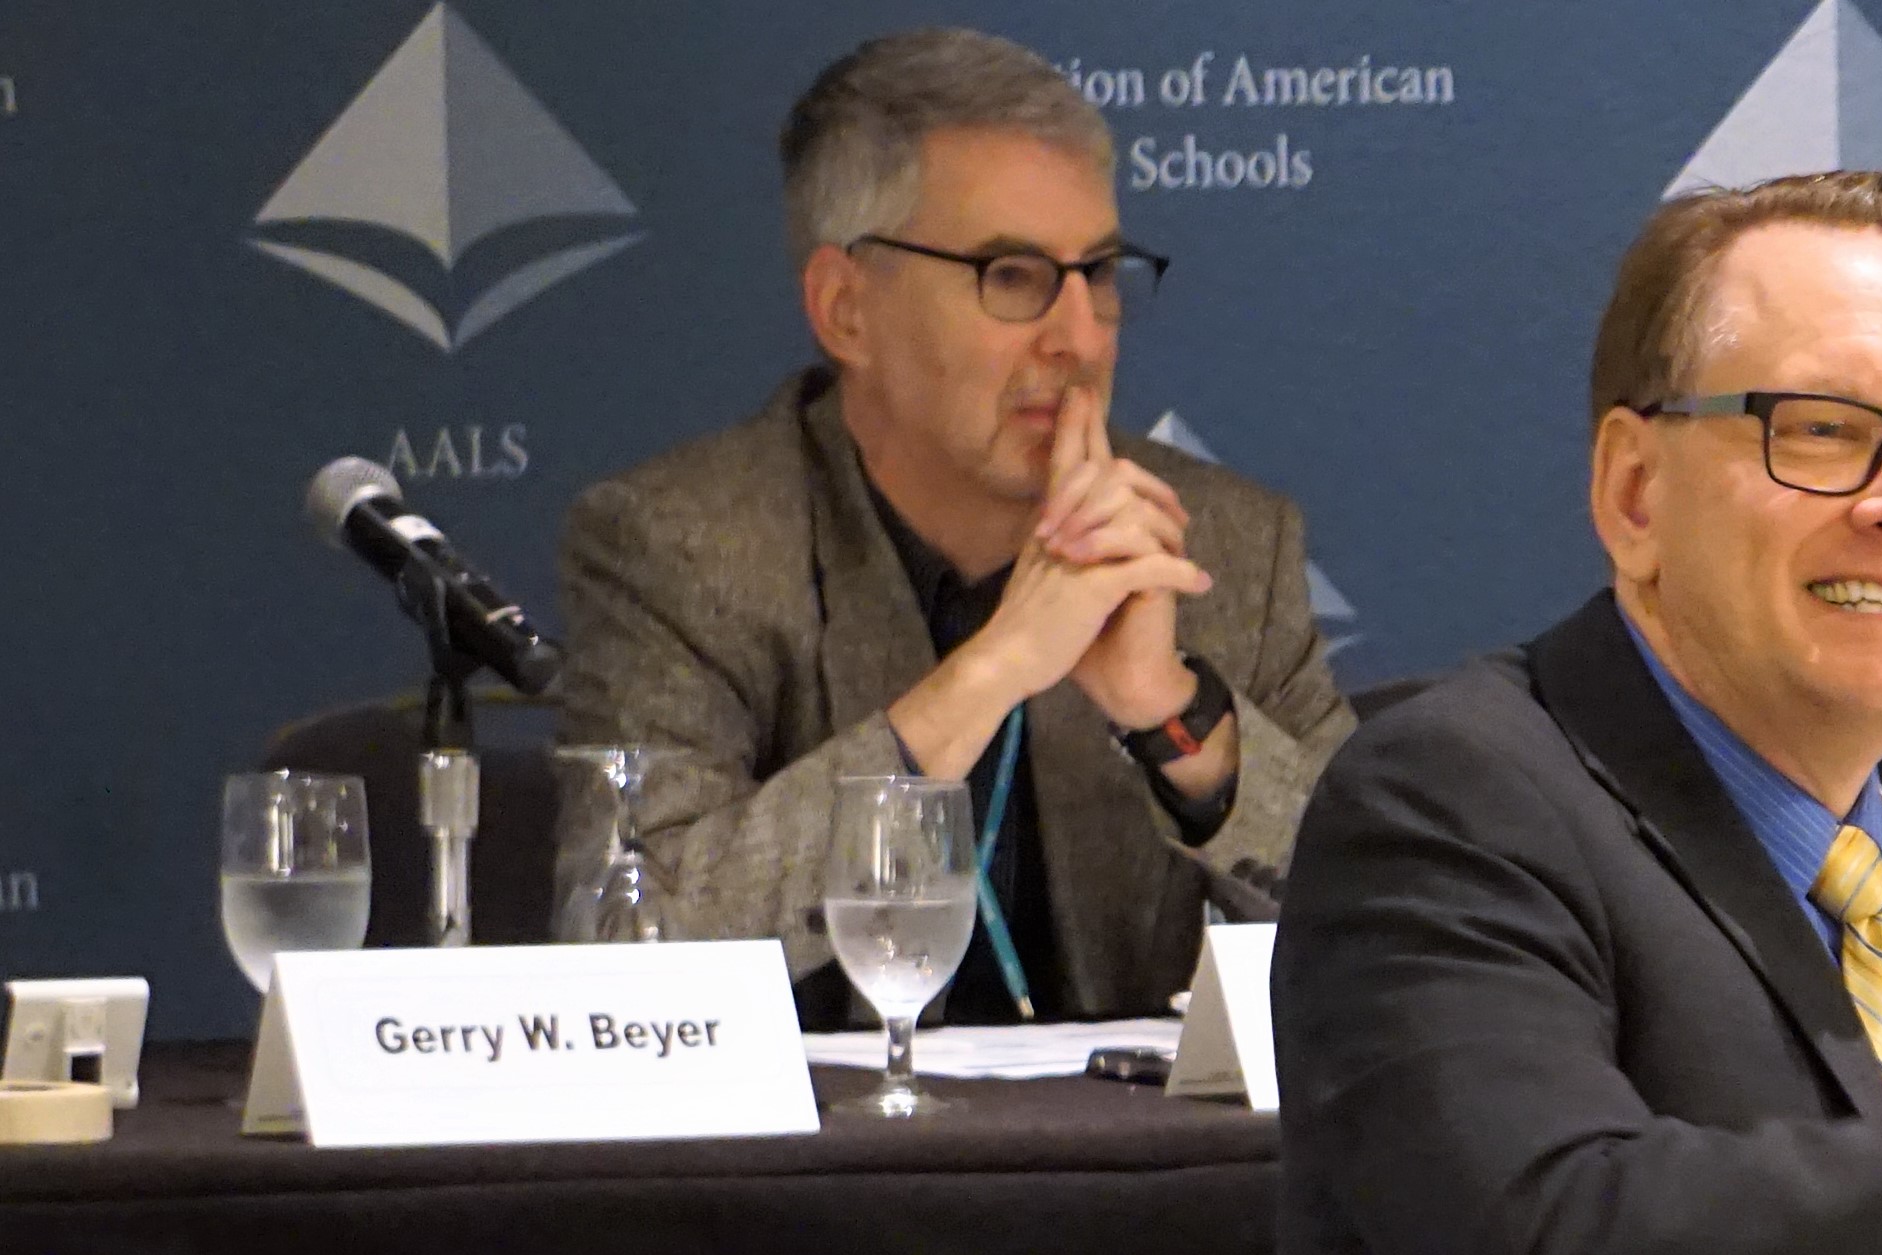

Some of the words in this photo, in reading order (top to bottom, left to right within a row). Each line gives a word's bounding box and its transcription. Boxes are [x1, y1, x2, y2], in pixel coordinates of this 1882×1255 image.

[1160, 51, 1215, 105] of
[1224, 51, 1457, 106] American
[1130, 133, 1315, 190] Schools
[388, 423, 528, 478] AALS
[374, 1015, 504, 1063] Gerry
[517, 1012, 574, 1052] W.
[588, 1011, 721, 1058] Beyer
